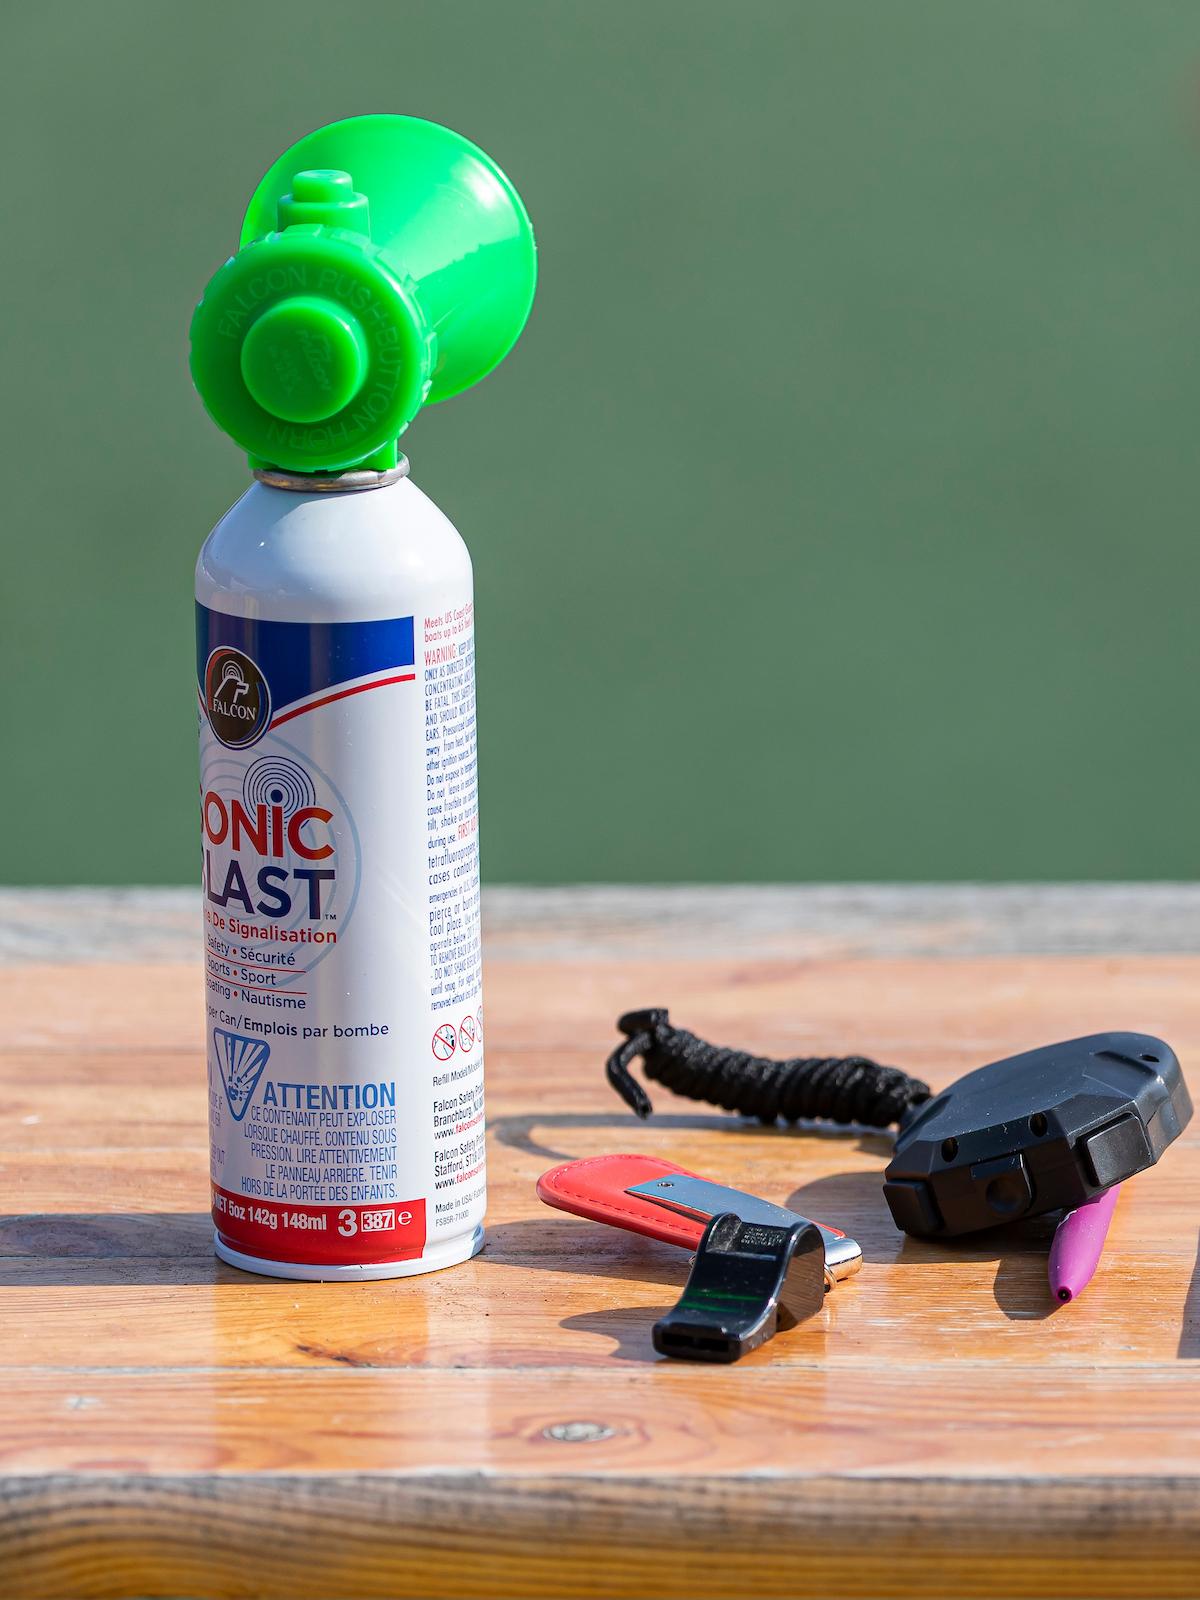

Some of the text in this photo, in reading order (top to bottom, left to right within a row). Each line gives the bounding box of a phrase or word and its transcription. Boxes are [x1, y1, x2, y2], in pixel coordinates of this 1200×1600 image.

[217, 265, 307, 339] FALCON
[213, 698, 257, 721] FALCON
[202, 849, 335, 920] LAST
[429, 870, 450, 885] cases
[213, 914, 225, 927] De
[229, 918, 337, 944] Signalisation
[240, 947, 296, 966] Sécurité
[240, 968, 277, 986] Sport
[241, 989, 306, 1010] Nautisme
[303, 1027, 328, 1040] par
[333, 1023, 389, 1038] bombe
[262, 1082, 396, 1110] ATTENTION
[433, 1098, 458, 1113] Falcon
[251, 1105, 397, 1128] CE CONTENANT PEUT EXPLOSER
[244, 1122, 397, 1146] LORSQUE CHAUFFÉ. CONTENU SOUS
[251, 1142, 398, 1164] PRESSION. LIRE ATTENTIVEMENT
[434, 1147, 459, 1163] Falcon
[266, 1163, 276, 1179] LE
[278, 1165, 320, 1182] PANNEAU
[370, 1164, 398, 1180] TENIR
[434, 1158, 464, 1177] Stafford,
[241, 1176, 262, 1195] HORS
[263, 1181, 275, 1197] DE
[276, 1183, 288, 1199] LA
[328, 1185, 349, 1201] DES
[351, 1183, 398, 1201] ENFANTS.
[229, 1200, 246, 1220] 5oz
[248, 1207, 278, 1230] 142g
[281, 1211, 328, 1231] 148ml
[337, 1209, 359, 1237] 3
[363, 1212, 393, 1231] 387
